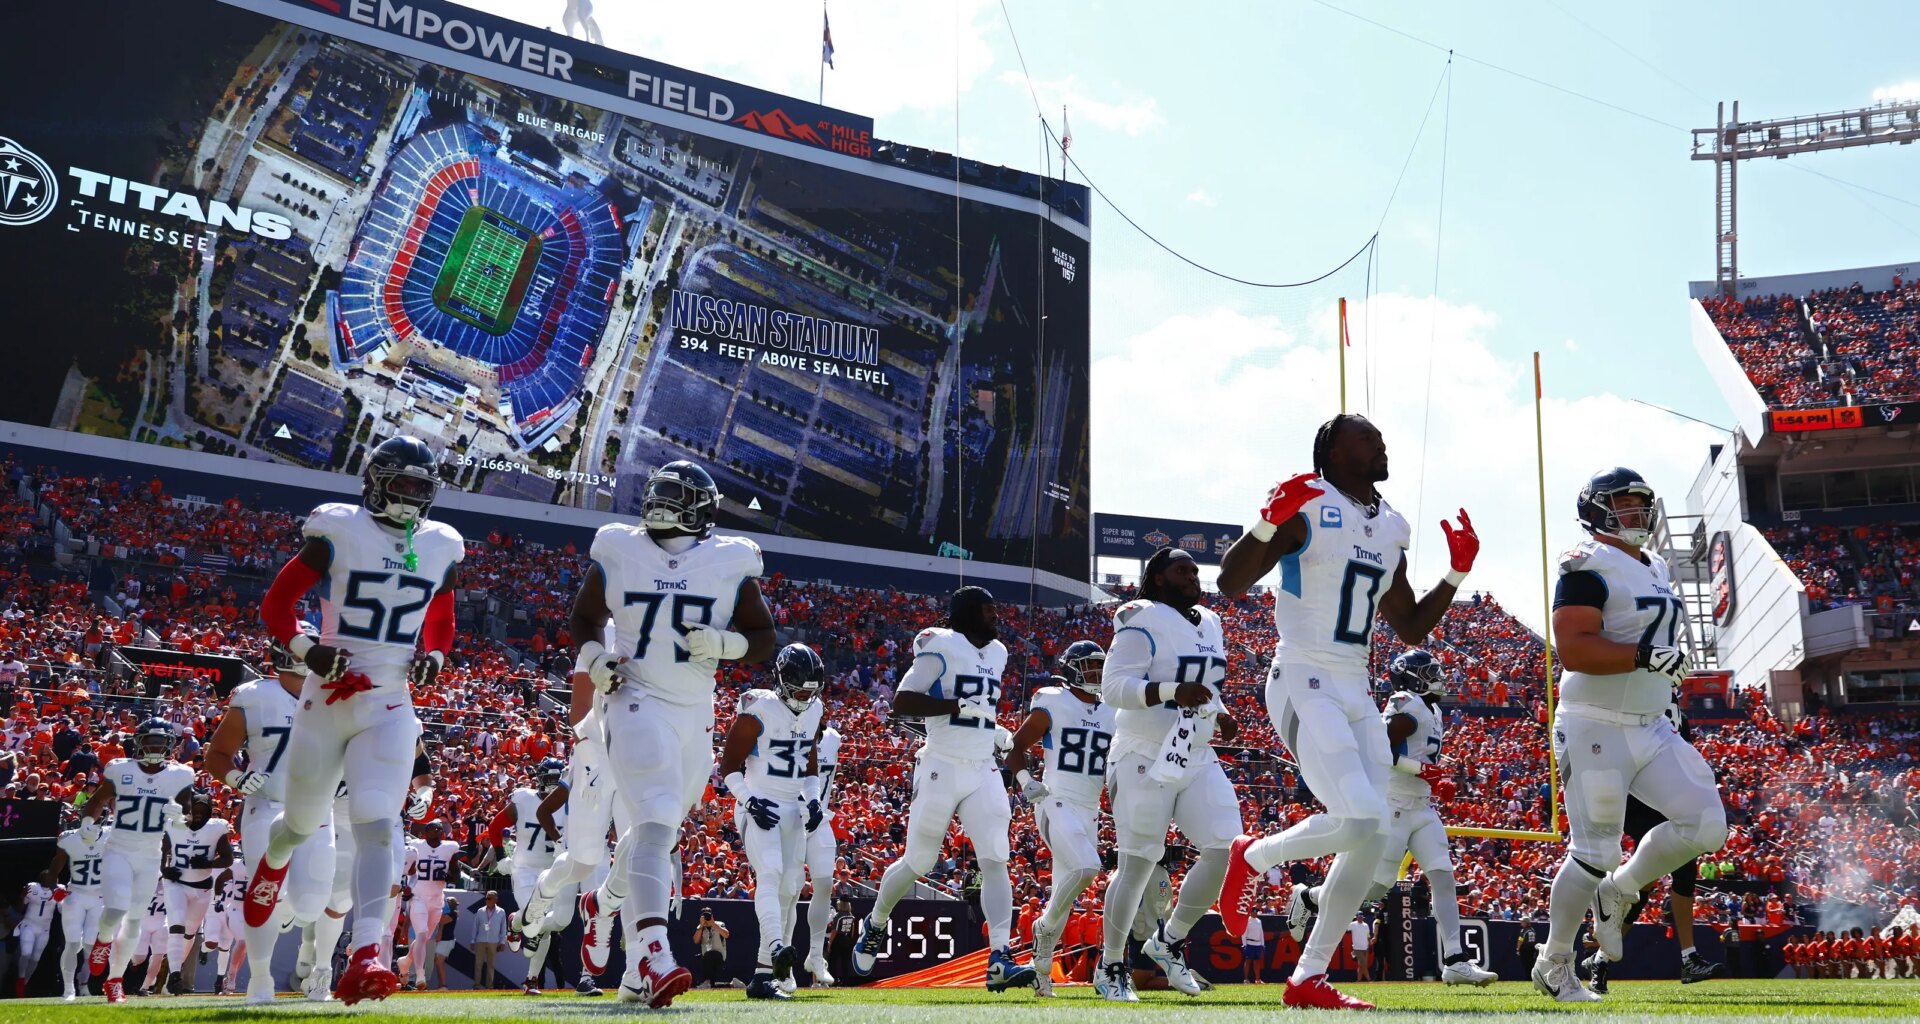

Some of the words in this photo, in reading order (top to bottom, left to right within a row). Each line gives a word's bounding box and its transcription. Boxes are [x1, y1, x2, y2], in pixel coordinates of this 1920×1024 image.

[349, 0, 573, 81] EMPOWER
[628, 70, 735, 122] FIELD
[517, 112, 547, 129] BLUE
[554, 122, 606, 144] BRIGADE
[817, 119, 830, 131] AT
[831, 124, 870, 145] MILE
[831, 138, 872, 159] HIGH
[69, 166, 293, 241] TITANS
[78, 209, 209, 252] TENNESSEE
[670, 289, 768, 346] NISSAN
[769, 309, 880, 366] STADIUM
[680, 335, 709, 353] 394
[718, 342, 756, 361] FEET
[760, 350, 807, 371] ABOVE
[813, 360, 840, 377] SEA
[846, 368, 889, 386] LEVEL
[1776, 416, 1803, 425] 1:54
[1807, 414, 1828, 424] PM
[456, 454, 530, 475] 36.1665°N
[546, 468, 617, 488] 86.7713°W
[1322, 507, 1341, 523] C
[1783, 511, 1800, 521] 300
[1102, 527, 1119, 537] SUPER
[1120, 529, 1136, 538] BOWL
[1103, 536, 1135, 546] CHAMPIONS
[382, 557, 414, 572] TITAN
[1353, 545, 1383, 565] TITANS
[653, 579, 687, 591] TITANS
[338, 569, 436, 646] 52
[1333, 558, 1387, 646] 0
[141, 660, 221, 682] verizon
[976, 664, 994, 676] TITANS
[1081, 719, 1101, 729] TITANS
[1057, 727, 1112, 776] 88
[137, 787, 158, 795] TITANS
[115, 795, 170, 832] 20
[838, 817, 845, 829] 2
[417, 859, 447, 881] 92
[1402, 896, 1414, 979] BRONCOS
